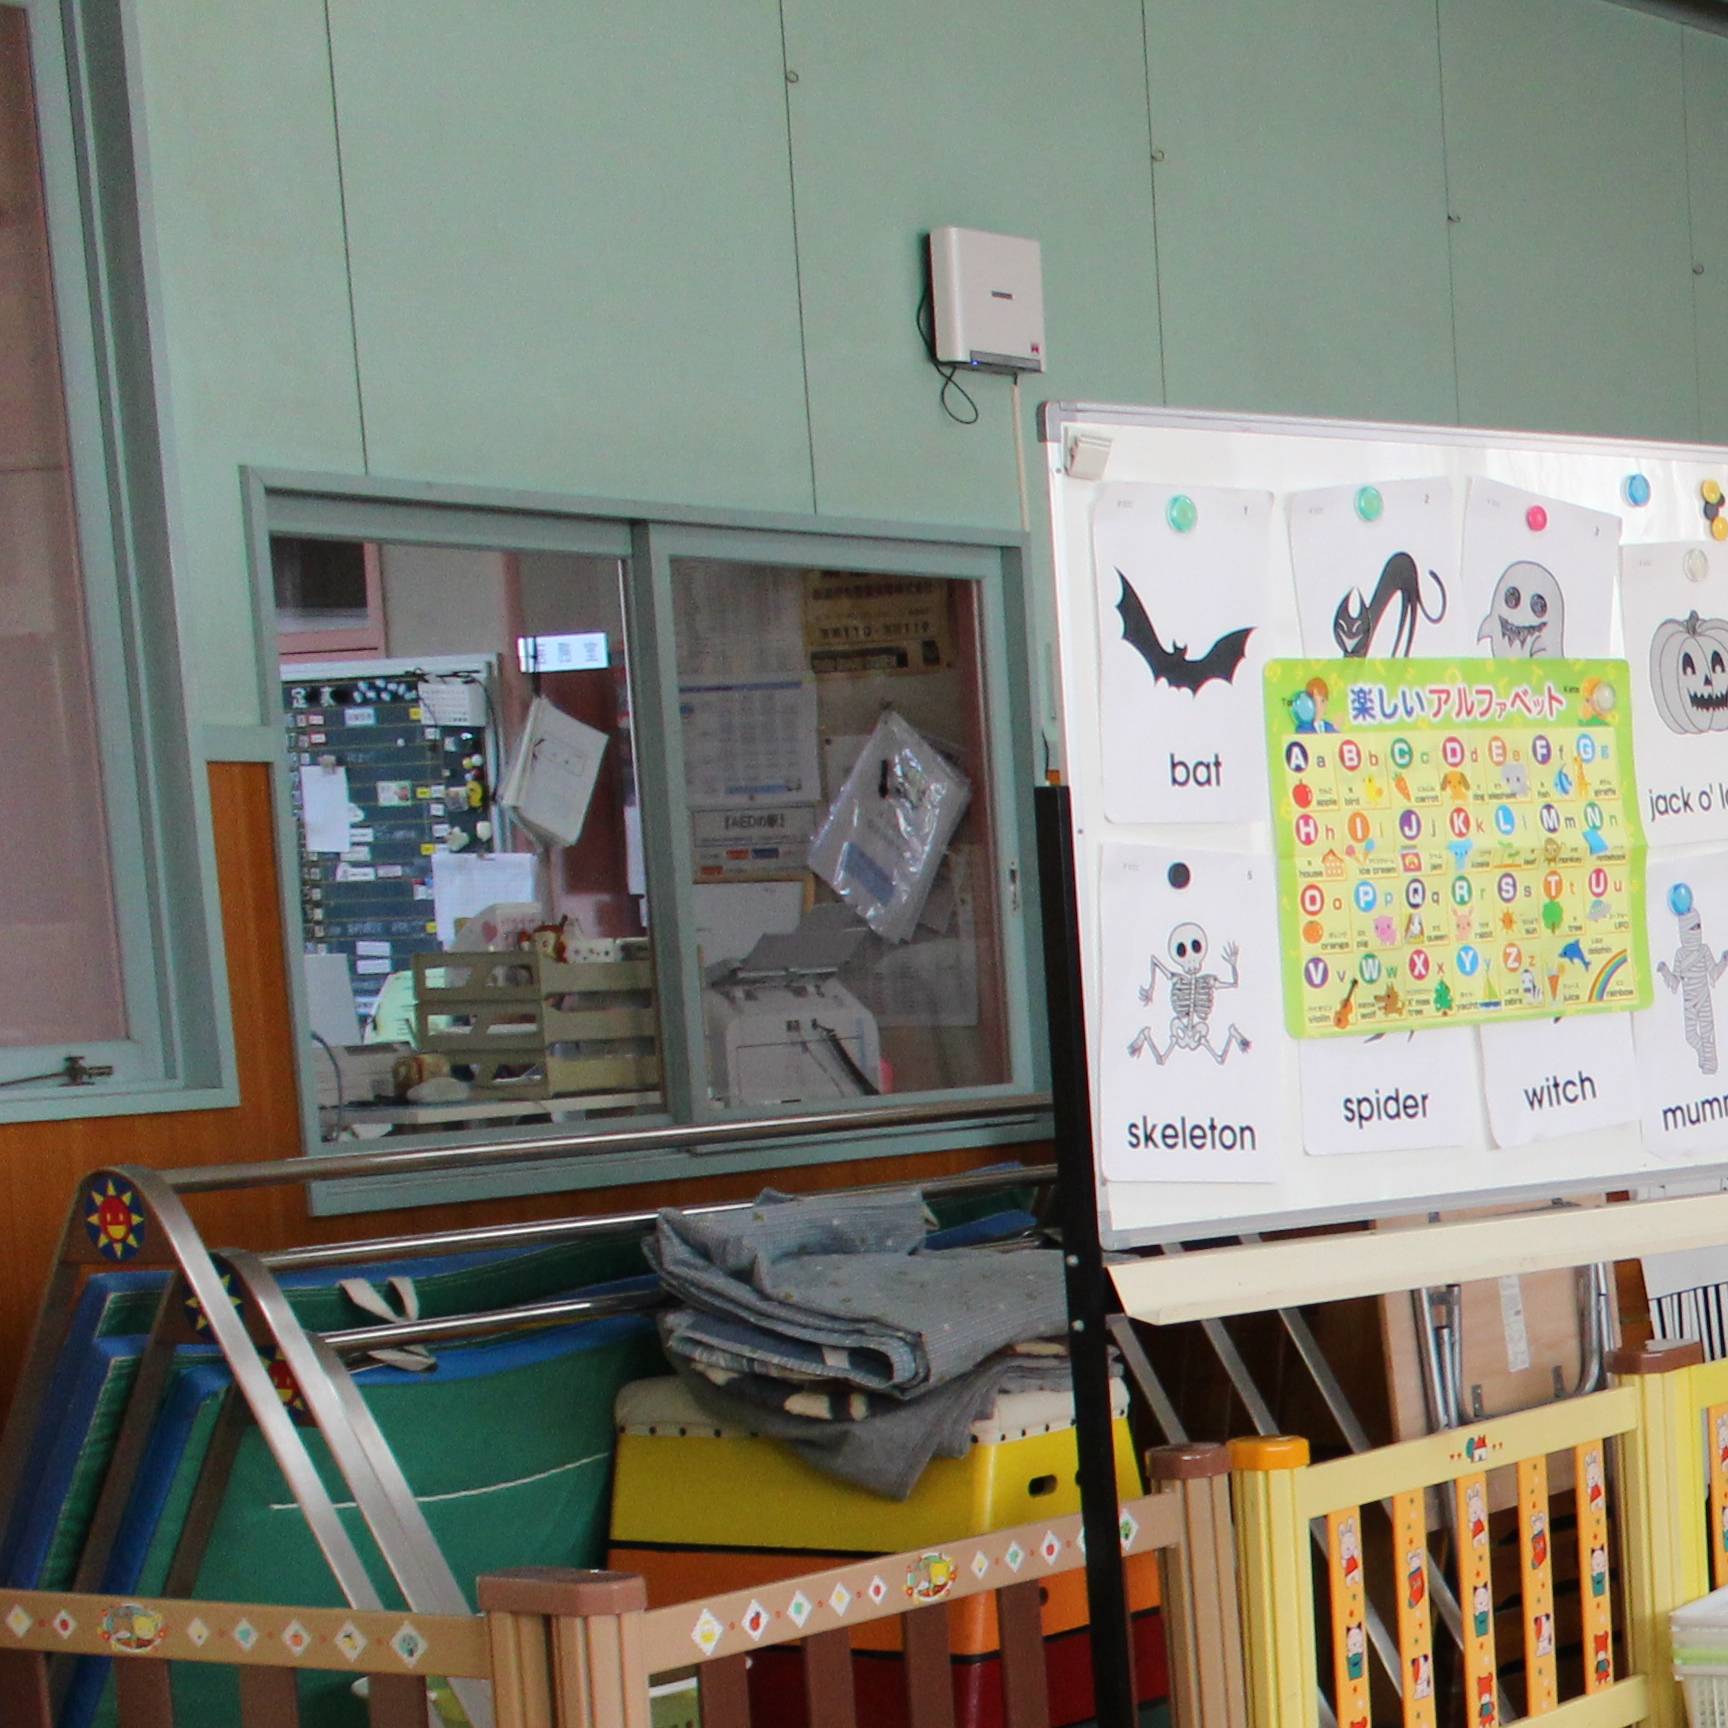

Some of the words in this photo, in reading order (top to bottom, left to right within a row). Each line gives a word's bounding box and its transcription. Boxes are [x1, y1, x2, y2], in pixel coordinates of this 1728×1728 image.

[1350, 684, 1563, 721] 楽しいアルファベット
[1170, 752, 1223, 787] bat
[1649, 786, 1694, 822] jack
[1699, 784, 1714, 812] o'
[1523, 1069, 1597, 1111] witch
[1343, 1088, 1429, 1130] spider
[1127, 1116, 1256, 1151] skeleton
